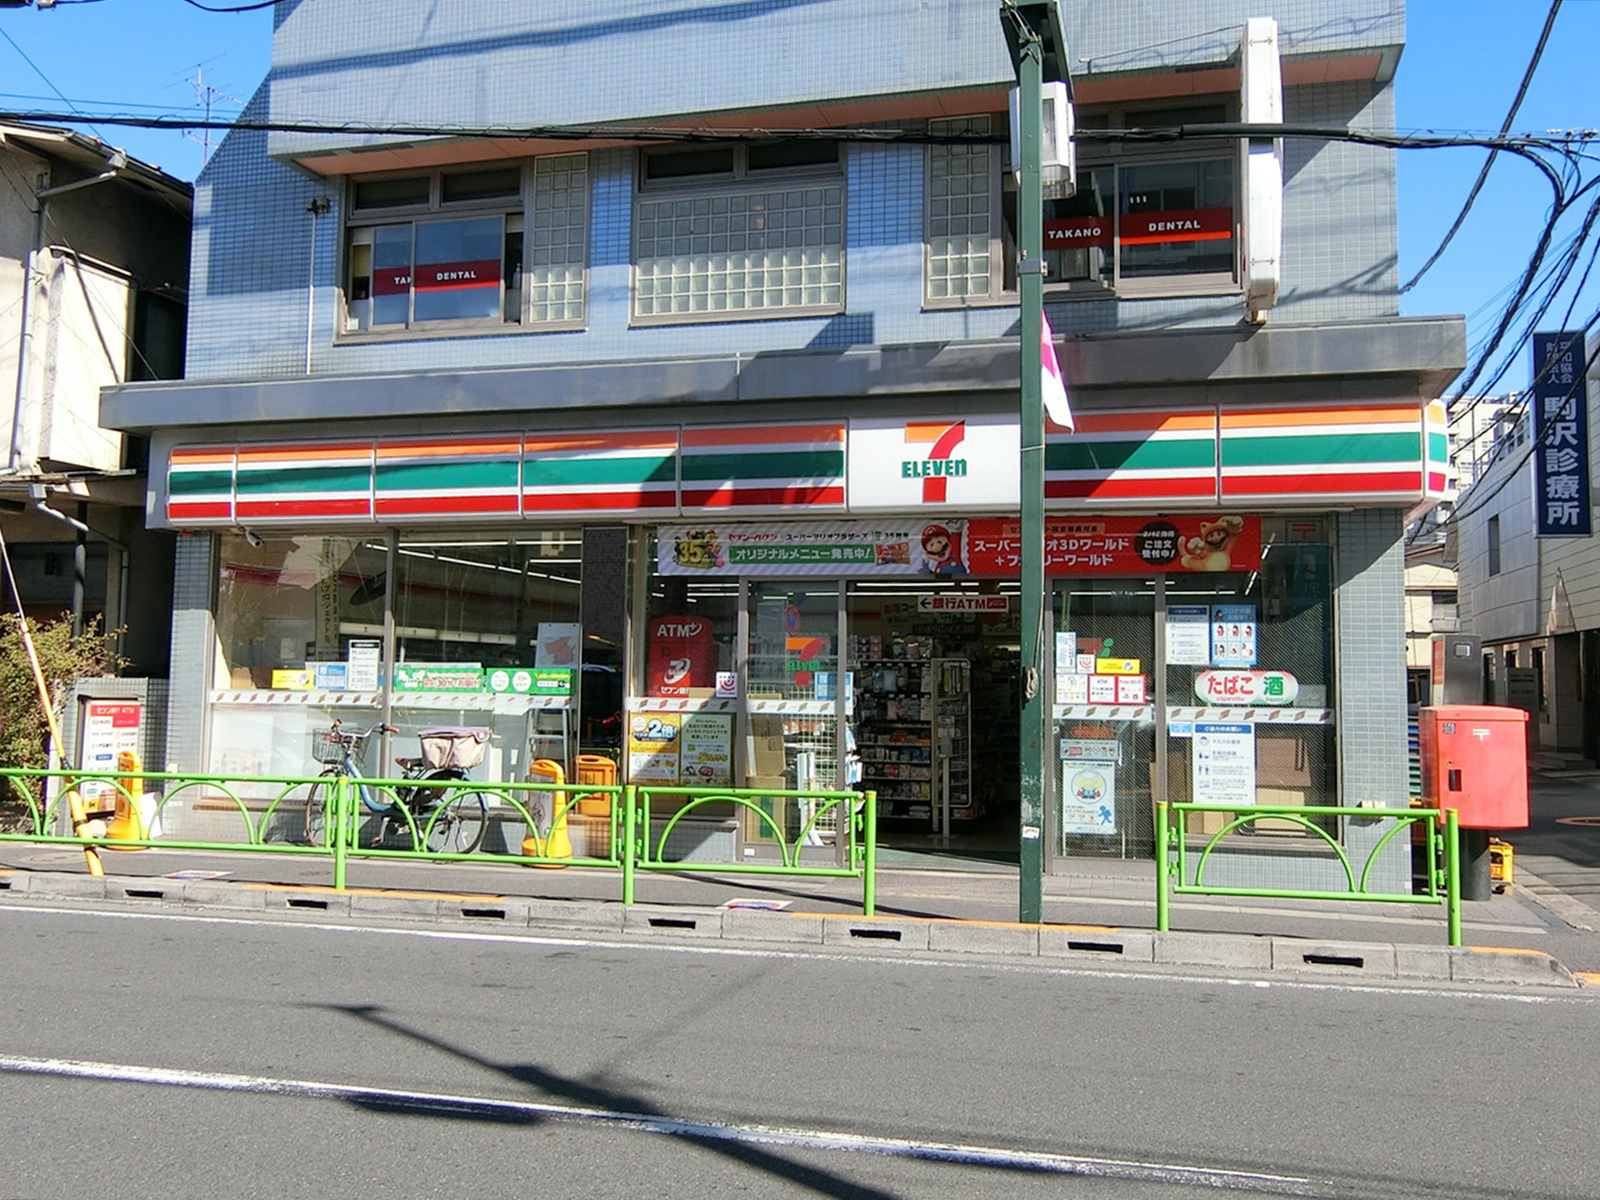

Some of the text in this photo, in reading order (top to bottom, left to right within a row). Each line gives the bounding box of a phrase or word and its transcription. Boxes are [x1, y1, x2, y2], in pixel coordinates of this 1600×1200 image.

[1148, 219, 1201, 232] DENTAL
[1048, 226, 1102, 240] TAKANO
[436, 270, 477, 281] DENTAL
[1544, 395, 1580, 526] 駒沢診療所
[932, 598, 986, 609] 銀行ATM
[1207, 676, 1254, 695] たばこ
[1263, 676, 1283, 695] 酒
